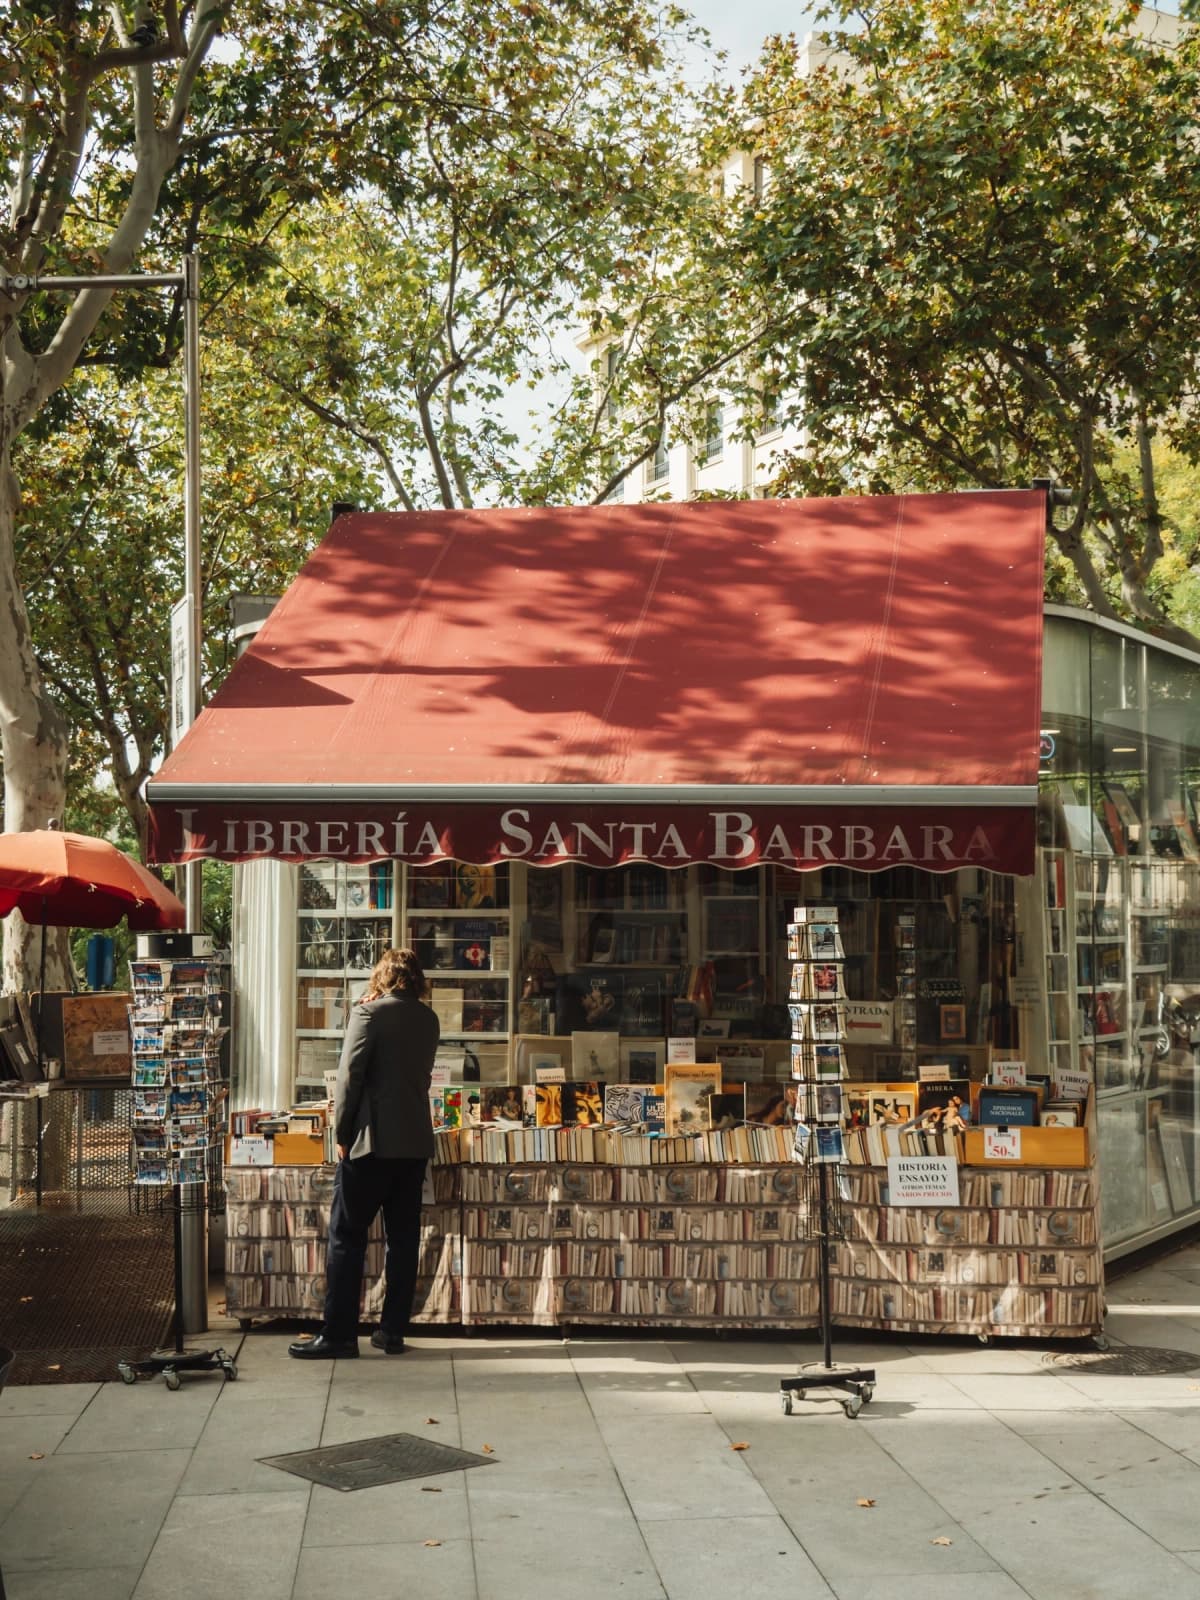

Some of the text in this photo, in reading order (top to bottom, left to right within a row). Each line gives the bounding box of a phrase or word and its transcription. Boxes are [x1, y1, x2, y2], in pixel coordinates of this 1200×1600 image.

[173, 808, 1001, 862] LIBRERÍA SANTA BARBARA
[845, 1006, 890, 1016] NTRADA
[993, 1145, 1008, 1157] 50
[898, 1163, 948, 1172] HISTORIA
[898, 1174, 949, 1183] ENSAYO Y
